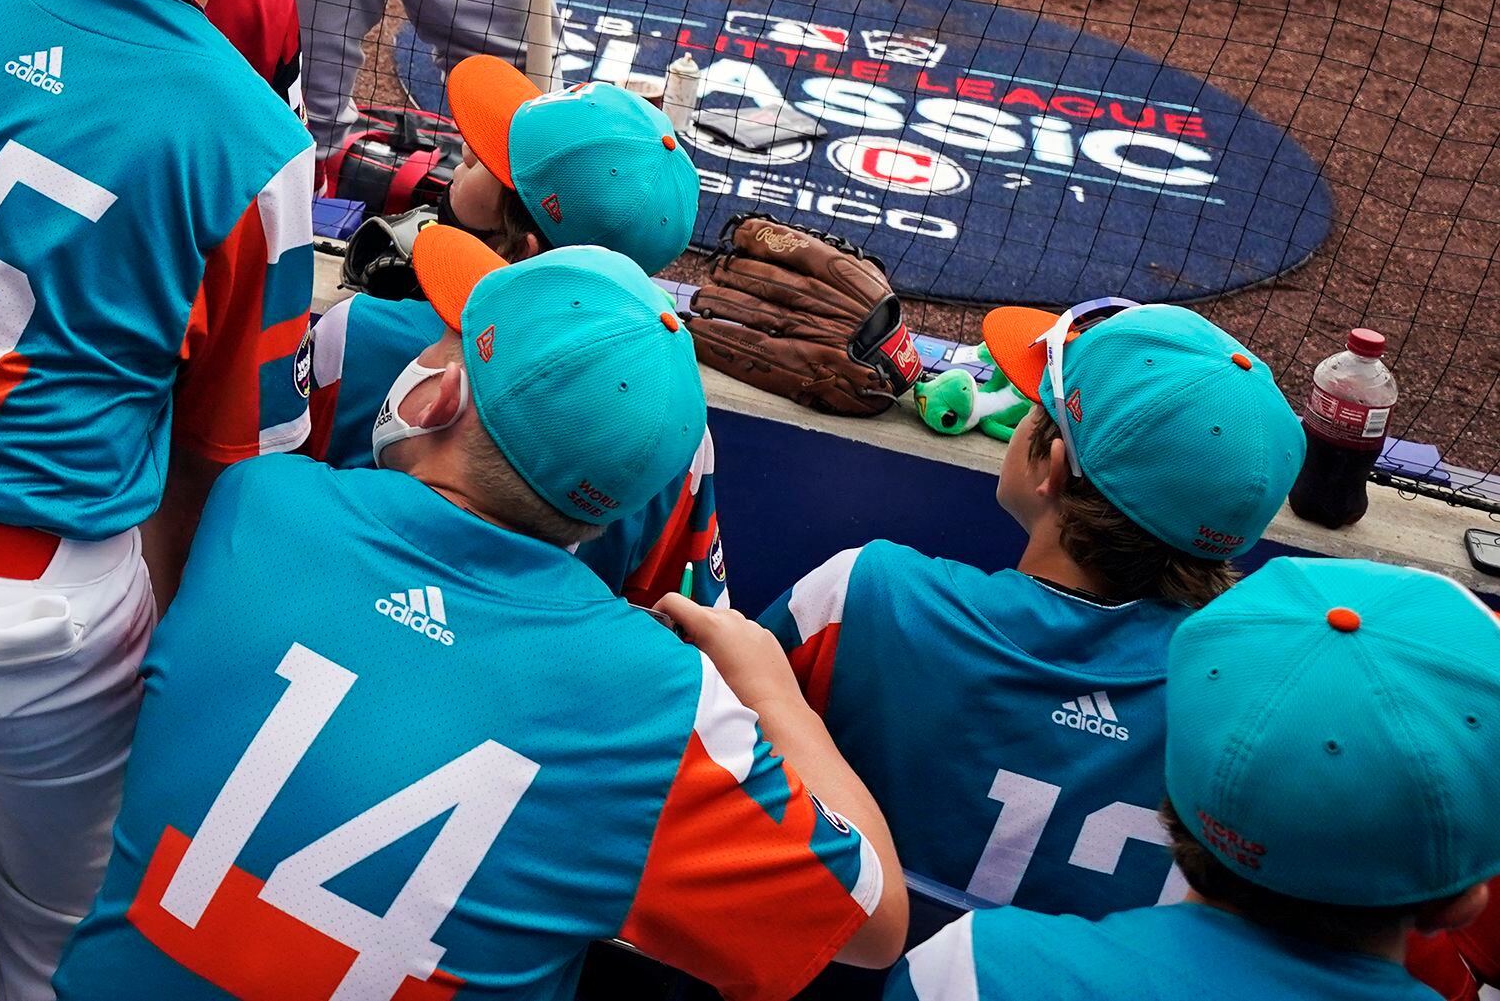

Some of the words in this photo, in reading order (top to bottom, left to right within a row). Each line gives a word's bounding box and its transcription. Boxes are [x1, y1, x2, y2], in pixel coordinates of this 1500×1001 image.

[4, 56, 65, 96] adidas
[676, 28, 889, 83] LITTLE
[916, 70, 1209, 139] LEAGUE
[755, 226, 811, 252] Rawlings
[1198, 524, 1245, 546] WORLD
[373, 596, 456, 647] adidas
[1050, 707, 1129, 742] adidas
[159, 641, 542, 1001] 14
